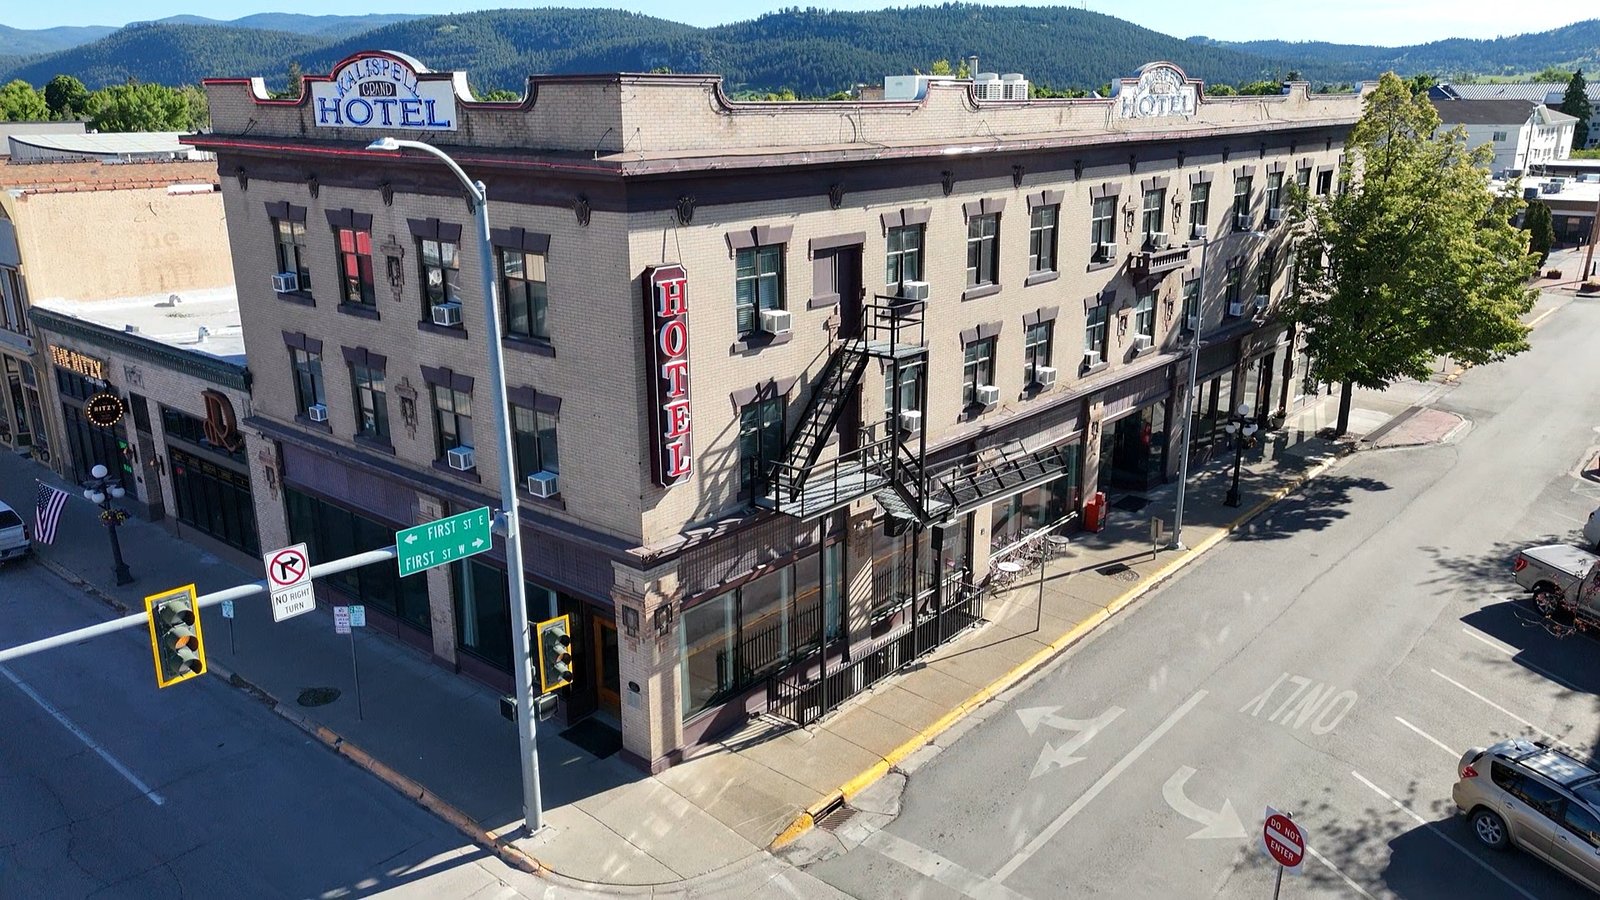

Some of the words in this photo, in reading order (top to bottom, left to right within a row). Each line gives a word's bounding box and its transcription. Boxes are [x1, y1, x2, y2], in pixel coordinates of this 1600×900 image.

[336, 58, 421, 99] KALISPELL
[362, 82, 393, 96] GRAND
[318, 97, 451, 127] HOTEL
[1121, 94, 1194, 118] HOTEL
[48, 344, 71, 369] THE
[70, 350, 102, 380] RITZY
[656, 278, 690, 477] HOTEL
[94, 404, 116, 412] RITZY
[428, 520, 456, 541] FIRST
[463, 518, 472, 530] ST
[478, 515, 484, 525] E
[405, 550, 435, 572] FIRST
[442, 548, 451, 560] ST
[458, 544, 465, 555] W
[275, 594, 288, 606] NO
[290, 588, 310, 601] RIGHT
[285, 601, 304, 615] TURN
[1239, 671, 1358, 735] ONLY
[1270, 818, 1281, 830] DO
[1284, 827, 1300, 843] NOT
[1270, 840, 1294, 862] ENTER
